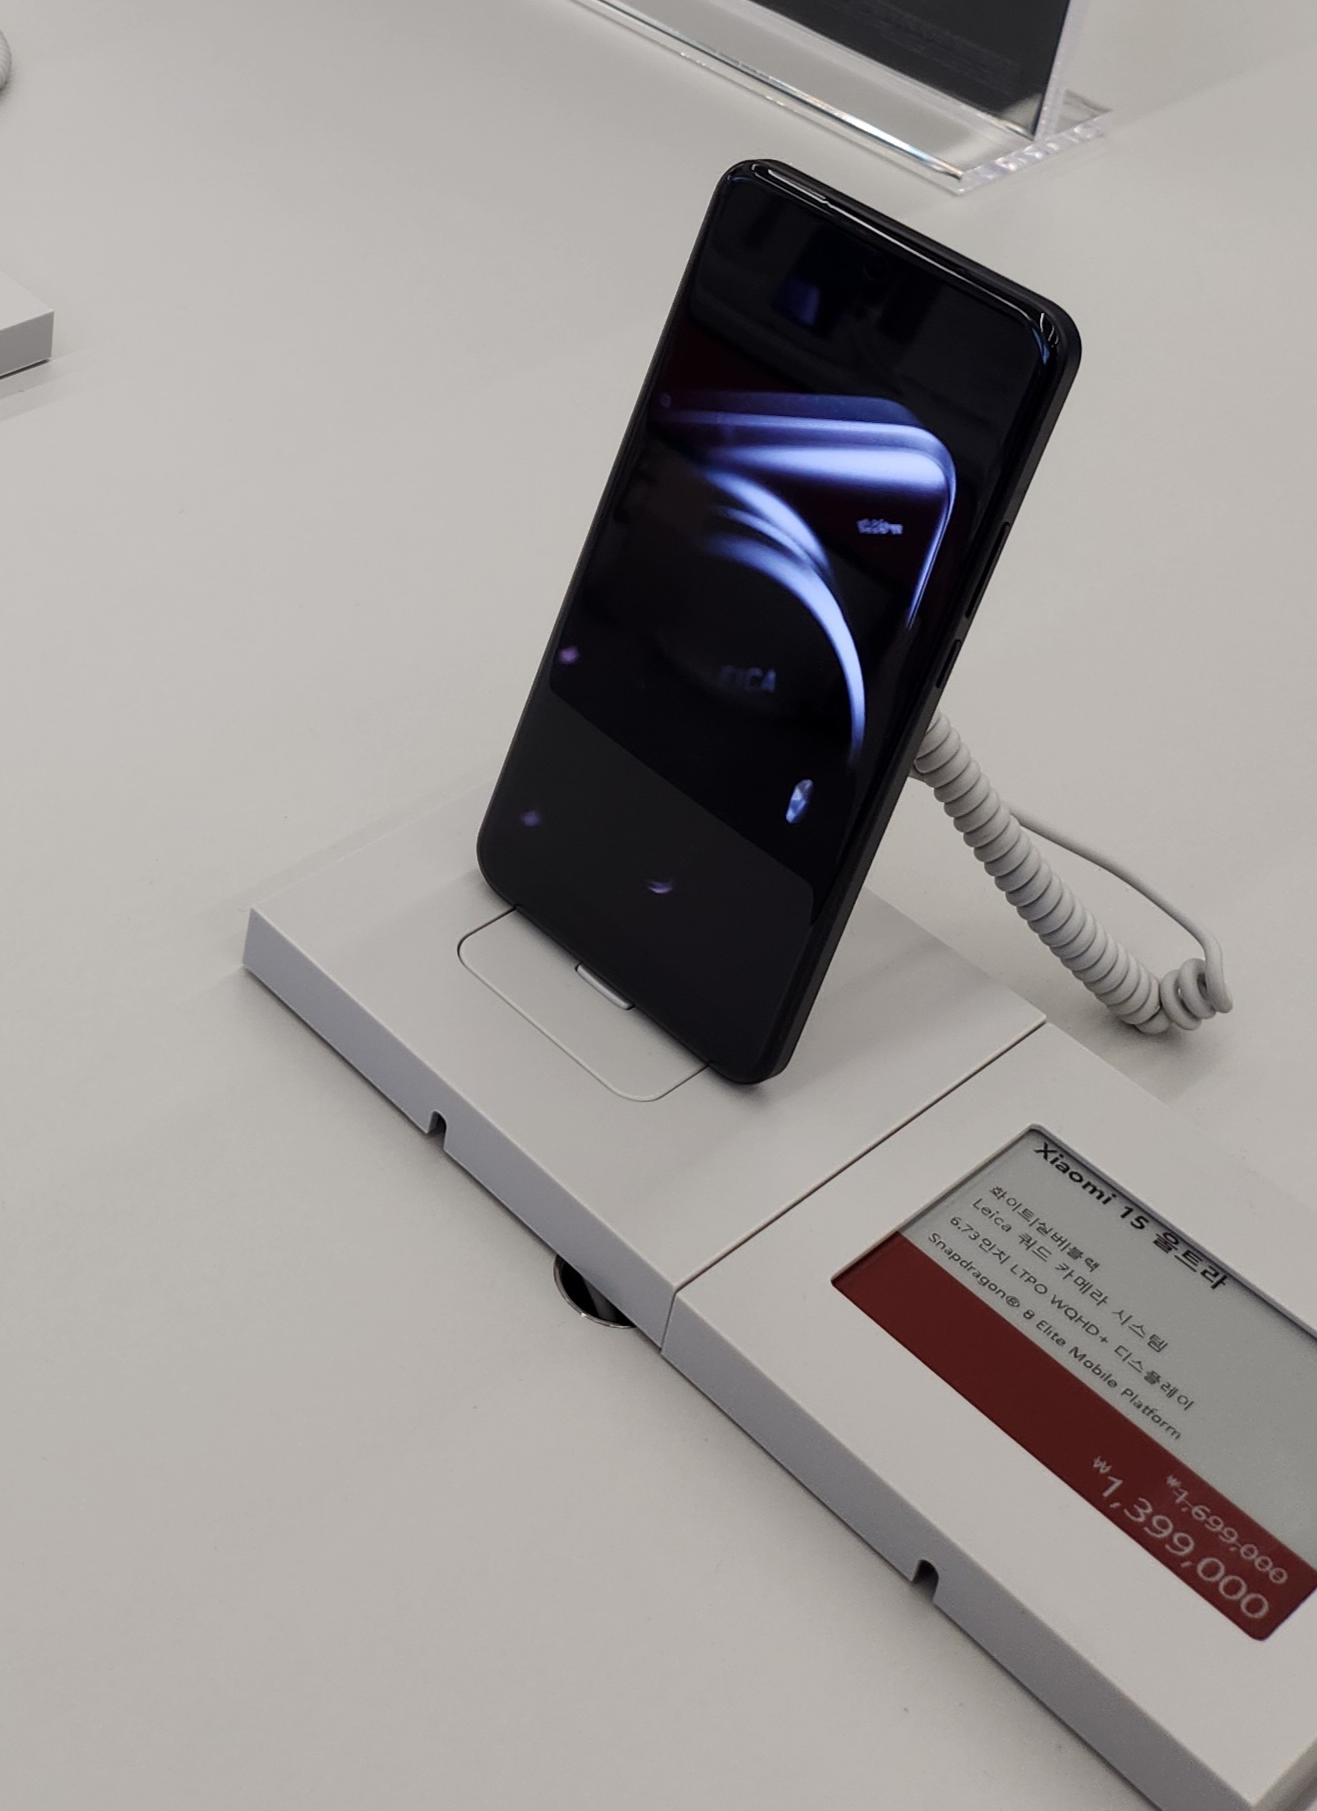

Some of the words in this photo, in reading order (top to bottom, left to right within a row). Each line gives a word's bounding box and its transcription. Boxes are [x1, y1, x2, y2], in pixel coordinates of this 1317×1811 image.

[970, 1196, 1013, 1233] Leica
[1053, 1261, 1109, 1307] 카메라
[1110, 1308, 1169, 1354] 시스템
[1032, 1141, 1117, 1205] Xiaomi
[1119, 1204, 1150, 1230] 15
[1151, 1230, 1232, 1290] 울트라
[1008, 1262, 1048, 1295] LTPO
[1049, 1292, 1109, 1343] WQHD+
[1112, 1343, 1195, 1412] 디스플레이
[1021, 1308, 1036, 1320] 8
[1034, 1318, 1066, 1347] Elite
[1067, 1345, 1118, 1388] Mobile
[1119, 1386, 1181, 1440] Platform
